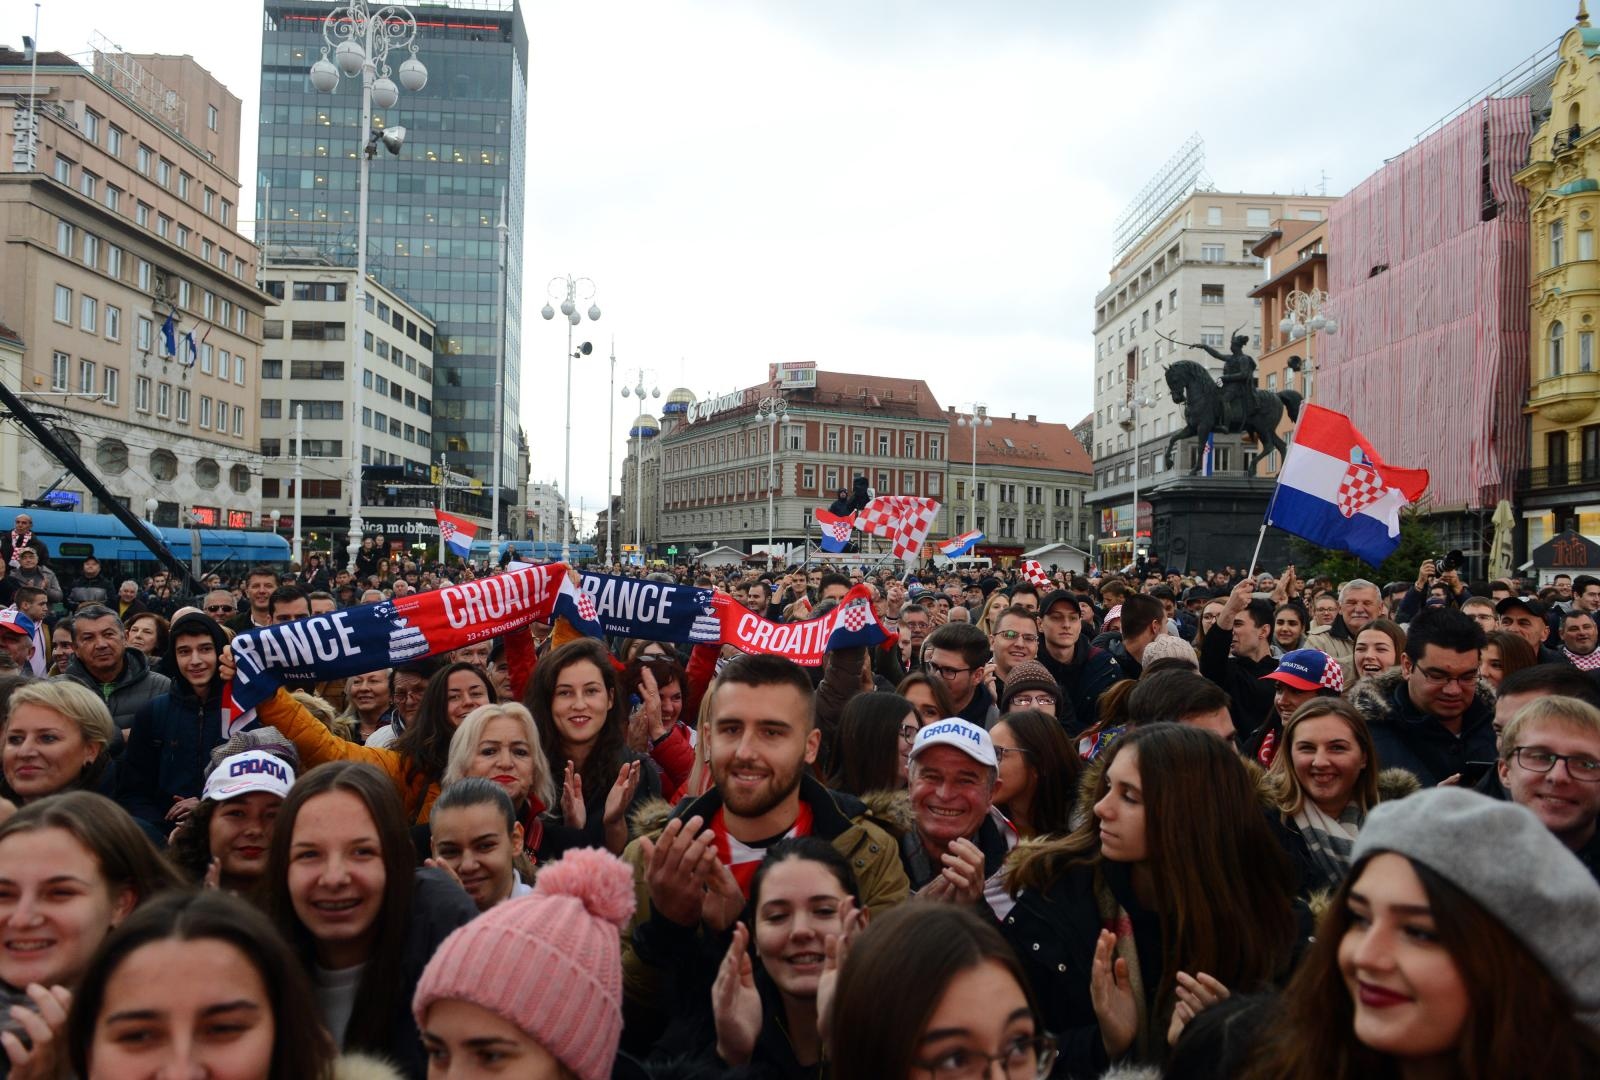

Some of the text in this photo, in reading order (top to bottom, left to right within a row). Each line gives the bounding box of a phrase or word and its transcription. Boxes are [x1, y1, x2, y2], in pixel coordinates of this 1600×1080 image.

[440, 566, 552, 629] CROATIE
[580, 575, 677, 624] RANCE
[491, 617, 529, 634] NOVEMBRE
[605, 624, 631, 633] FINALE
[737, 614, 832, 655] CROATIE
[284, 671, 317, 680] FINALE
[923, 724, 981, 745] CROATIA
[230, 758, 288, 785] CROATIA
